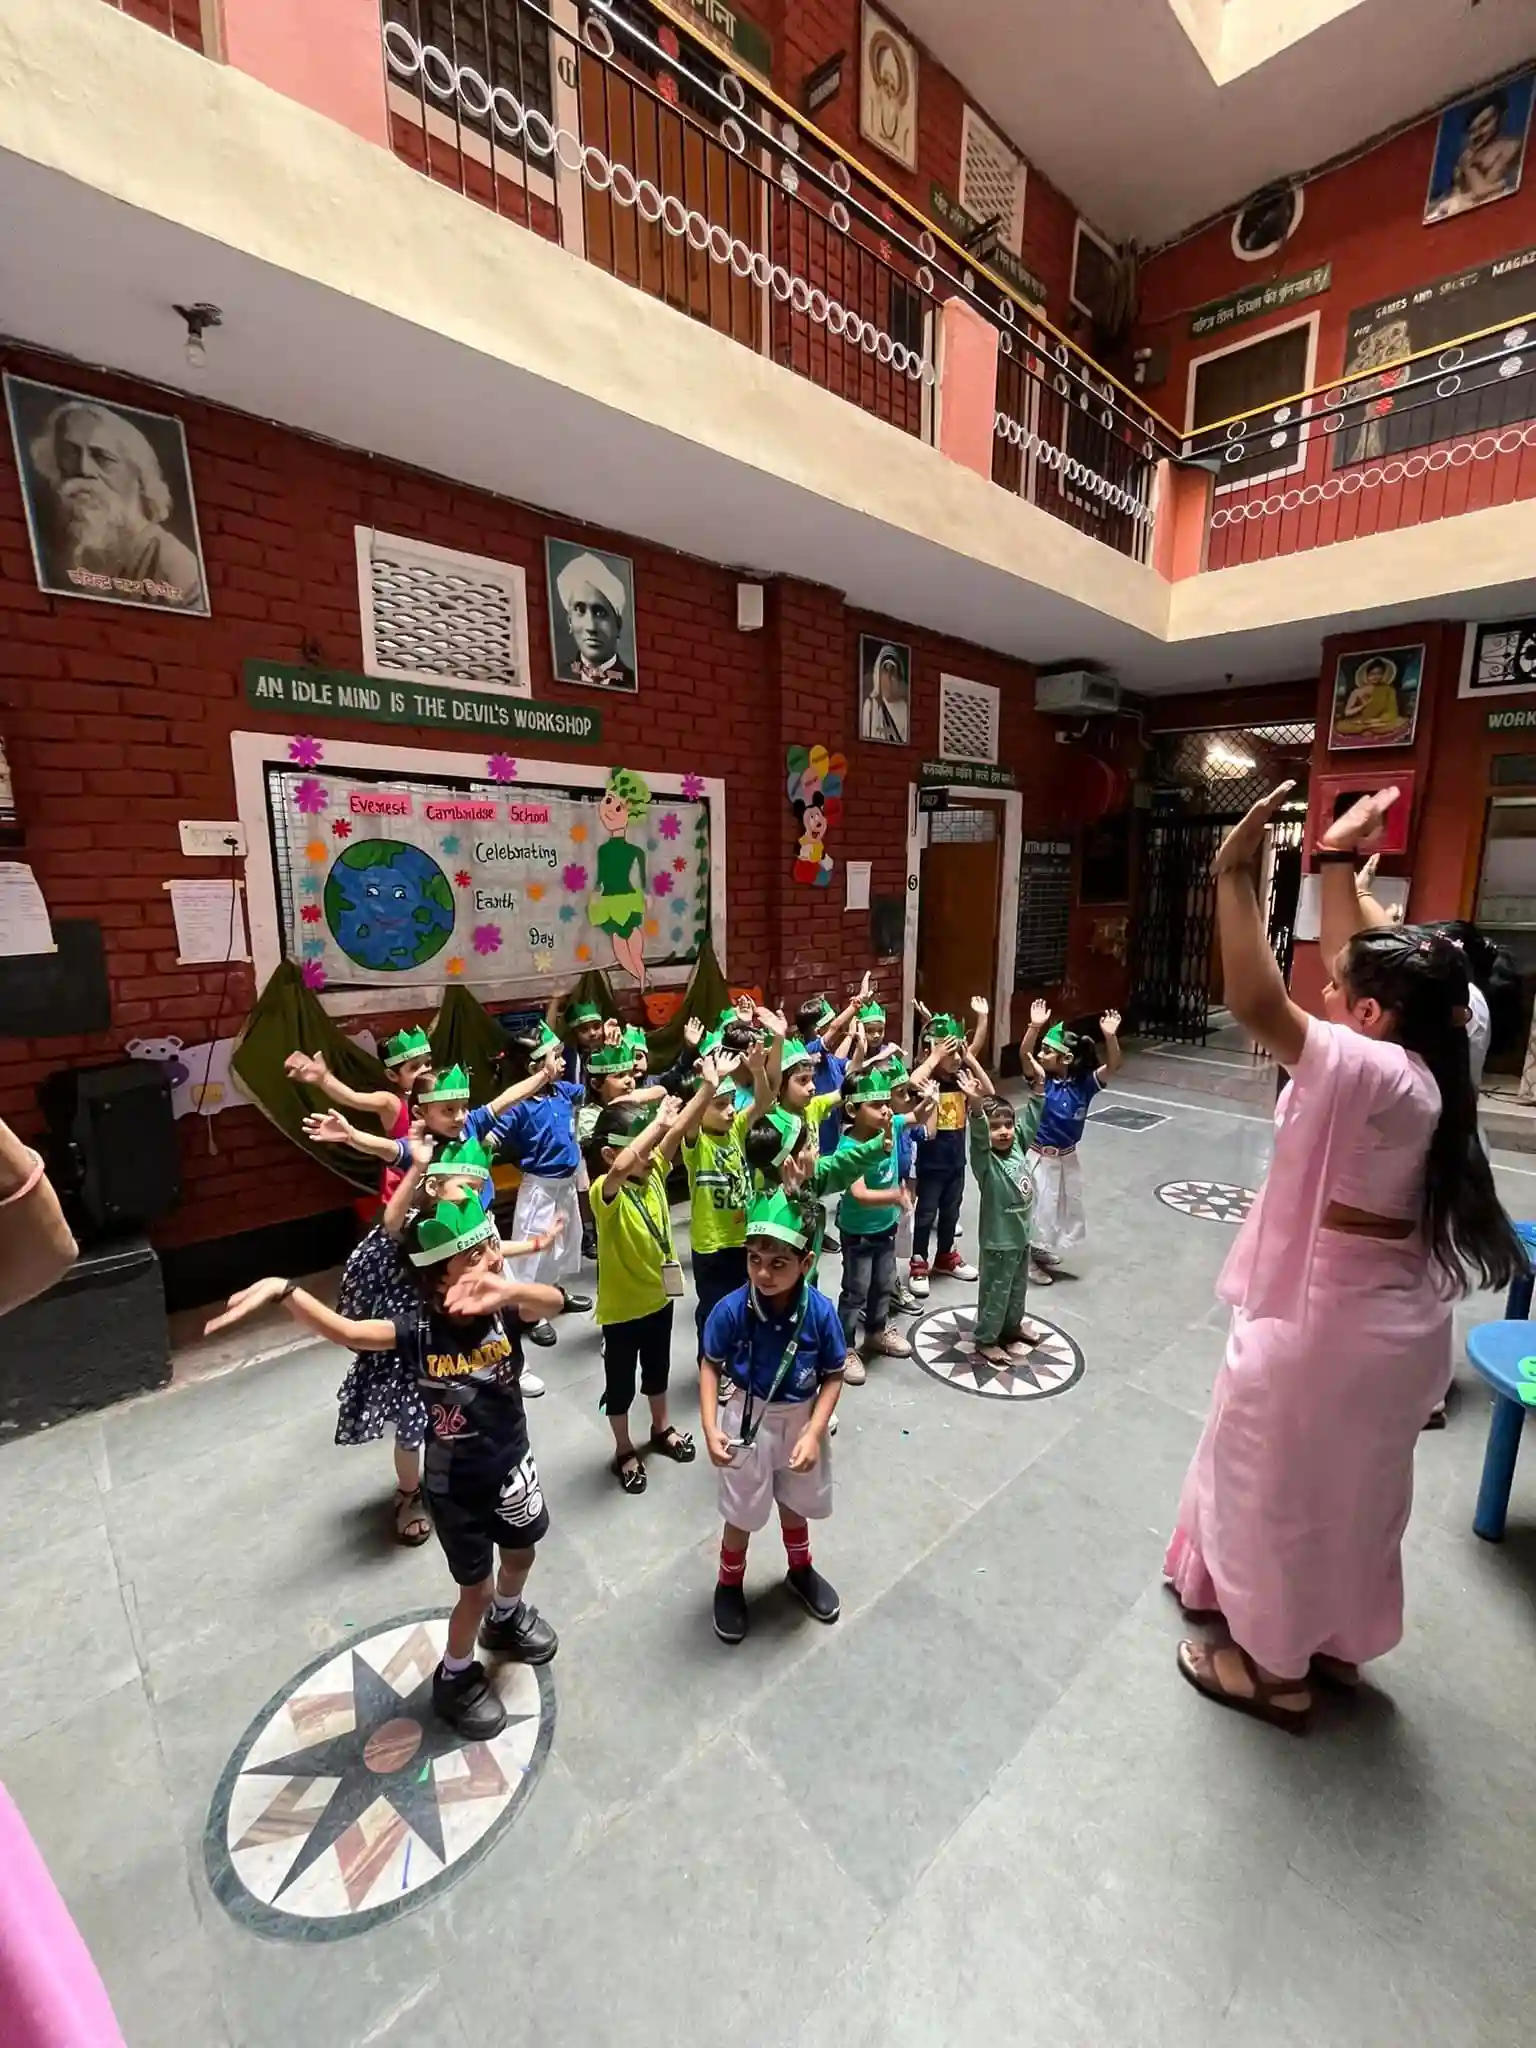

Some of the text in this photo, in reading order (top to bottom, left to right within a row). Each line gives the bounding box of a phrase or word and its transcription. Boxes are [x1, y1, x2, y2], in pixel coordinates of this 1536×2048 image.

[1375, 298, 1408, 319] GAMES
[1412, 289, 1433, 305] AND
[255, 675, 592, 737] AN IDLE MIND IS THE DEVIL'S WORKSHOP
[1488, 710, 1536, 729] WORK
[350, 795, 549, 824] Everest Cambridge School
[475, 842, 558, 868] Celebrating
[475, 890, 514, 911] Earth
[528, 927, 555, 949] Day
[431, 1403, 467, 1436] 26
